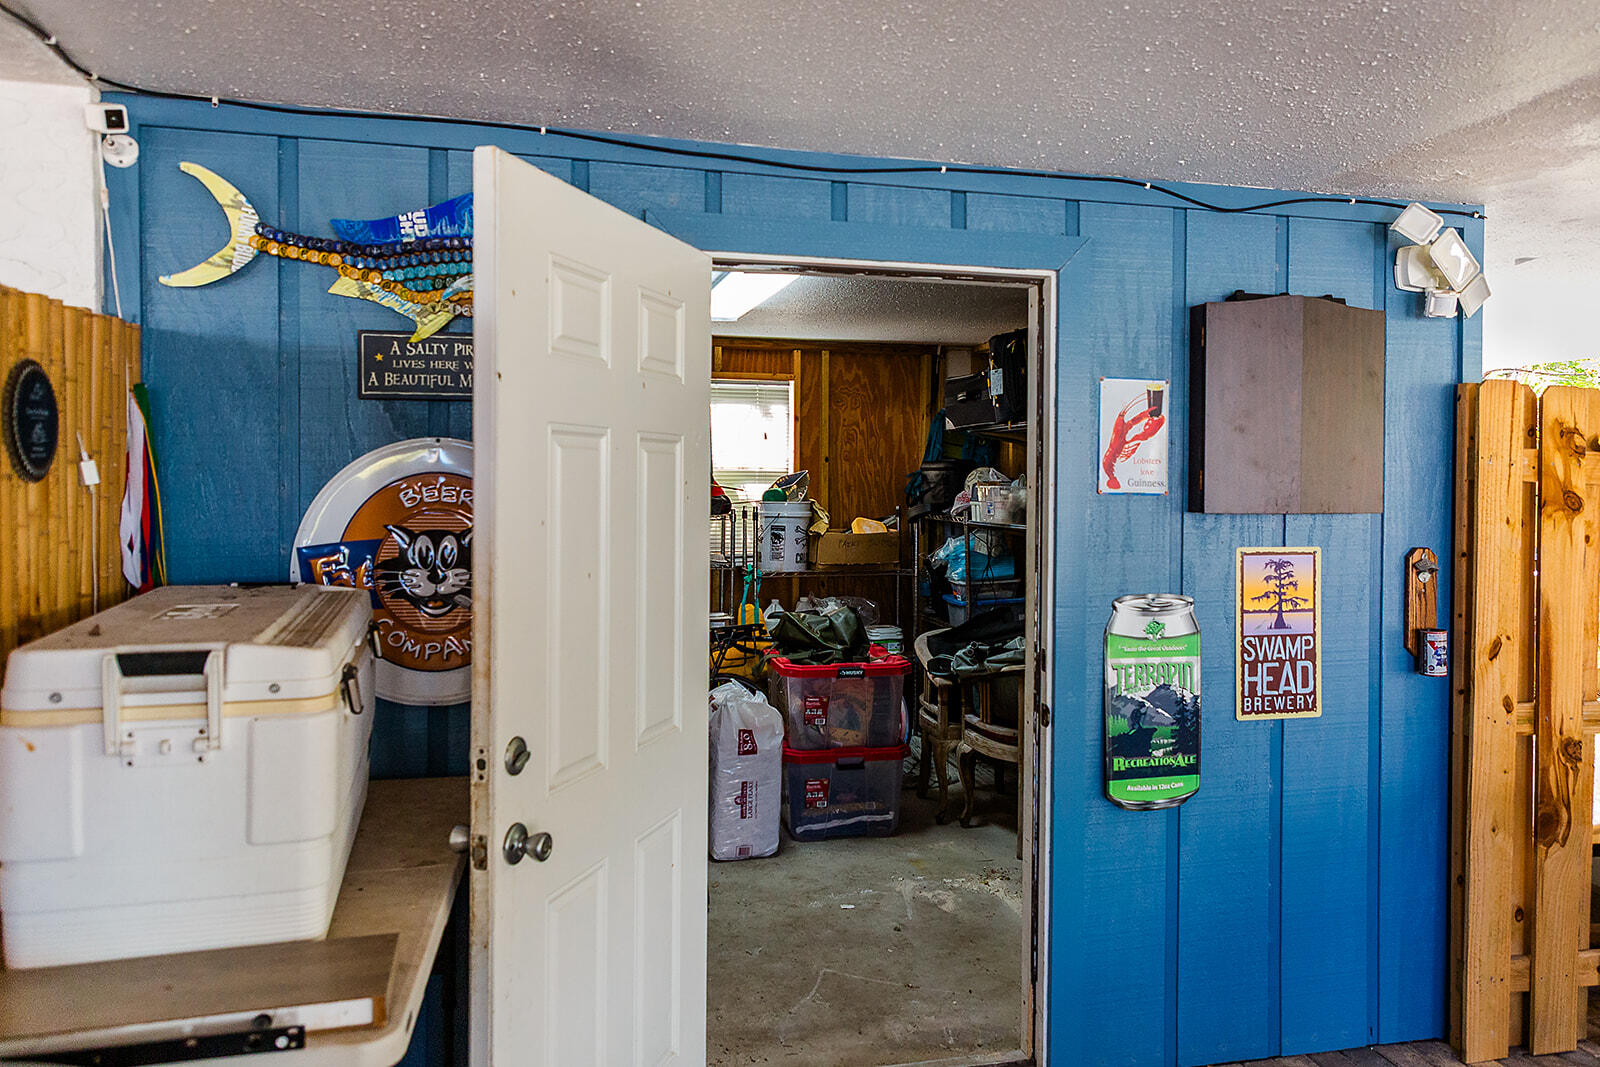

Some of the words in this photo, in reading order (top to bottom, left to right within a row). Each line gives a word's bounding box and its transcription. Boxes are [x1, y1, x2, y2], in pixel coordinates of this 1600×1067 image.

[390, 341, 401, 355] A
[406, 342, 449, 356] SALTY
[453, 343, 474, 356] PIR
[392, 360, 426, 369] LIVES
[430, 360, 460, 372] HERE
[368, 372, 379, 386] A
[384, 372, 455, 388] BEAUTIFUL
[459, 373, 472, 387] M
[399, 485, 473, 508] BEER
[377, 618, 473, 661] COMPAN
[1243, 635, 1314, 662] SWAMP
[1112, 662, 1195, 696] TERRAPIN
[1244, 661, 1314, 697] HEAD
[1243, 695, 1315, 712] BREWERY
